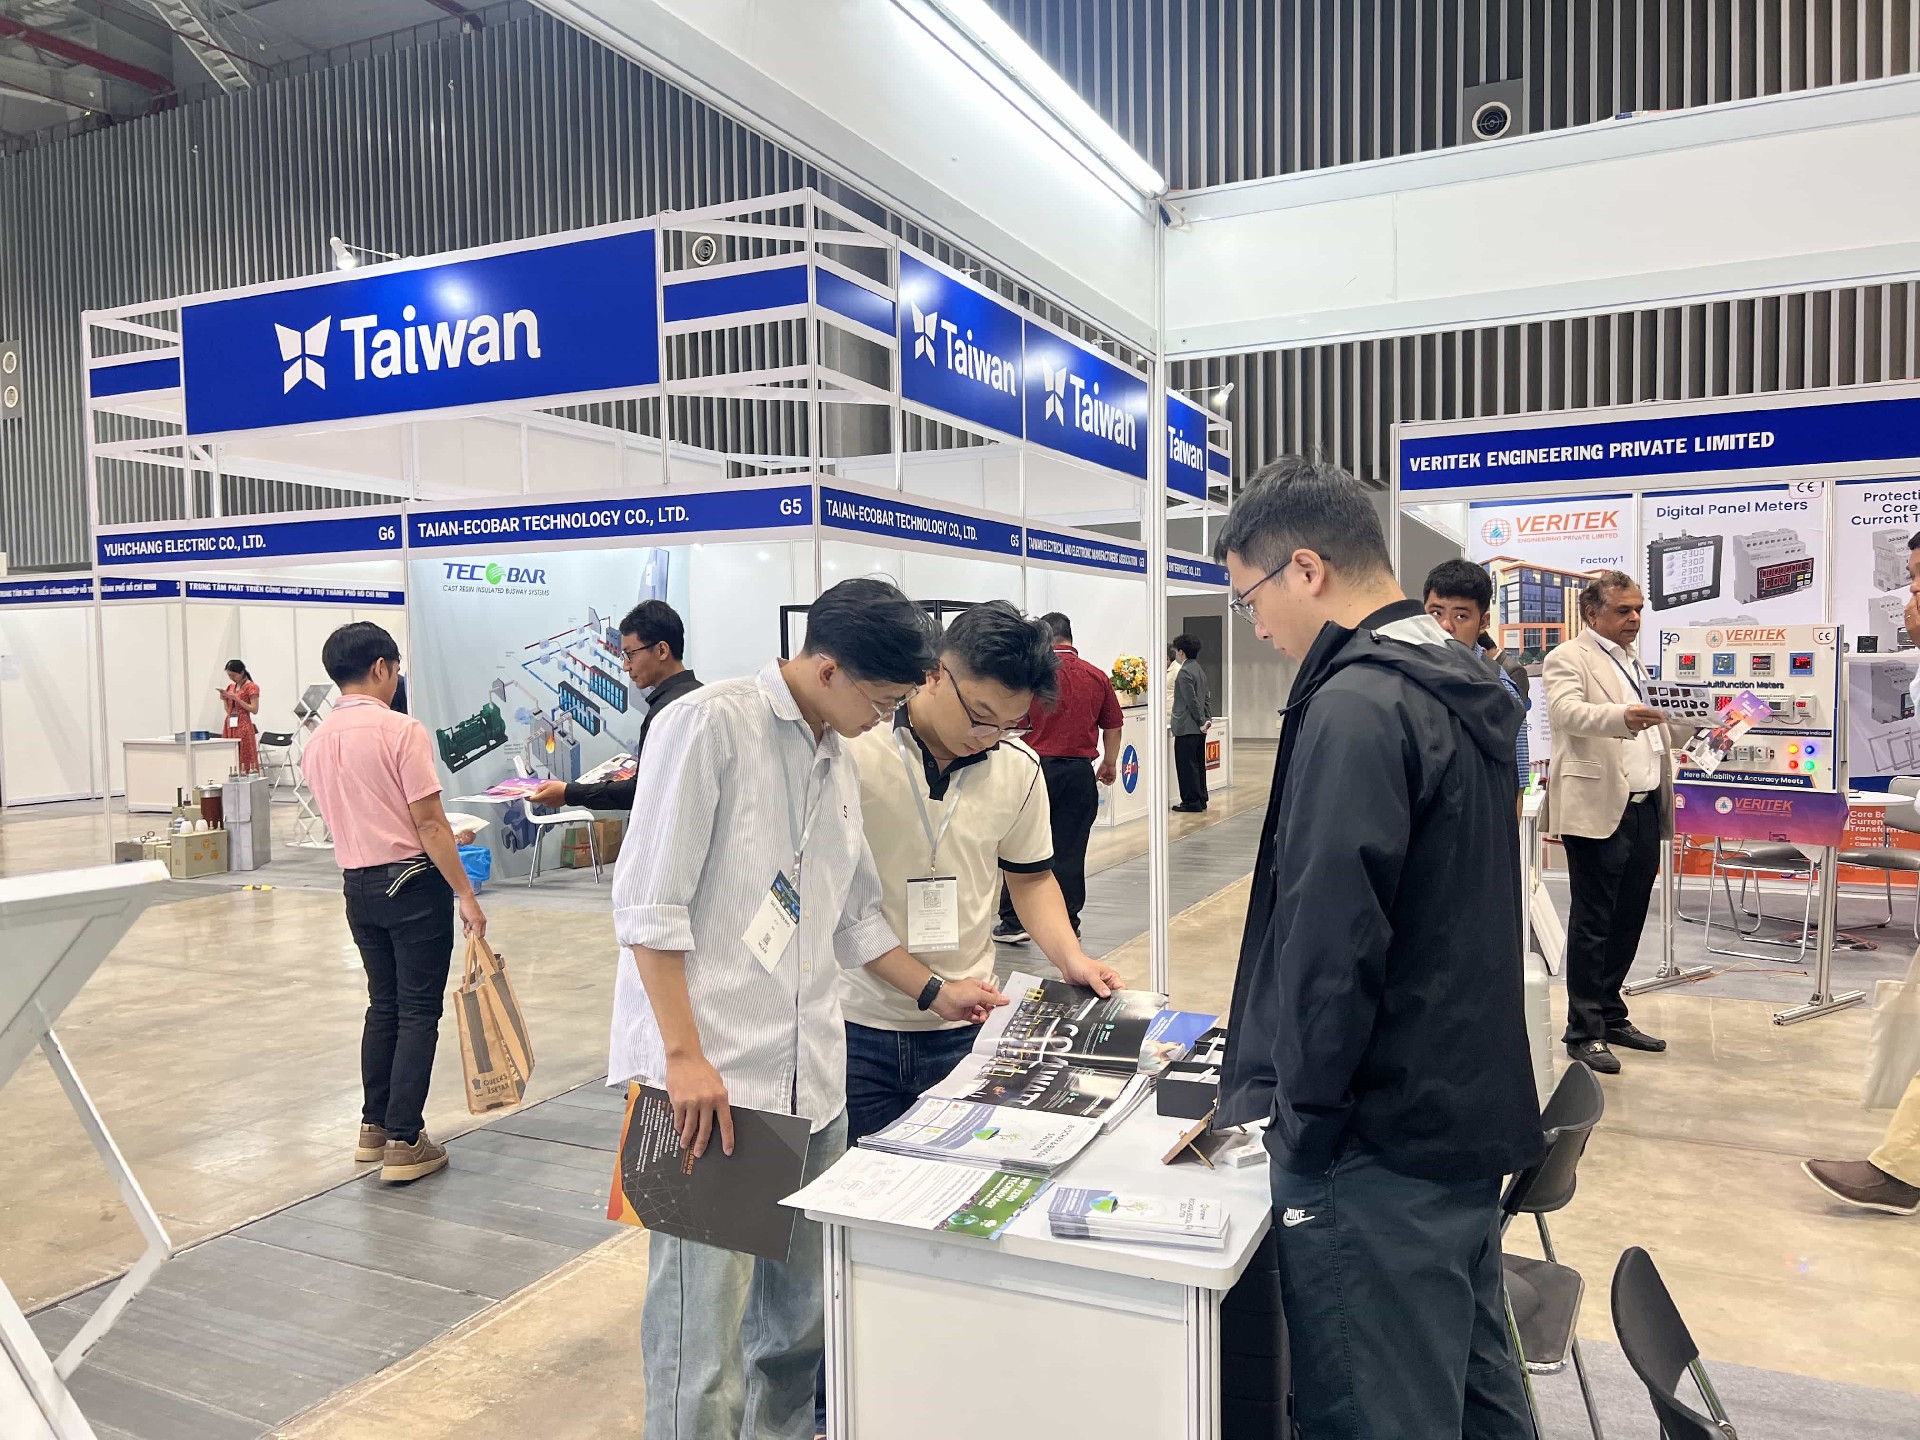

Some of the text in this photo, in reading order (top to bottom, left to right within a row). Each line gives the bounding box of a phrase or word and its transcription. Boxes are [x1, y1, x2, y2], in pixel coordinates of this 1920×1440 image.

[340, 305, 541, 380] Taiwan
[941, 319, 1016, 397] Taiwan
[1069, 373, 1137, 450] Taiwan
[1168, 425, 1204, 472] Taiwan
[1409, 431, 1775, 472] VERITEK ENGINEERING PRIVATE LIMITED
[1656, 500, 1808, 520] Digital Panel Meters
[1882, 503, 1918, 513] Core
[417, 498, 802, 538] TAIAN-ECOBAR TECHNOLOGY CO., LTD. G5
[826, 499, 895, 525] TAIAN-ECOBAR
[895, 512, 948, 535] TECHNOLOGY
[963, 525, 978, 541] LTD.
[1010, 533, 1019, 548] G5
[1515, 510, 1620, 533] VERITEK
[1851, 514, 1909, 525] Current
[103, 526, 395, 557] YUHCHANG ELECTRIC CO., LTD. G6
[1517, 535, 1562, 544] ENGINEERING
[1591, 532, 1619, 540] LIMITED
[1580, 556, 1619, 565] Factory
[443, 584, 458, 592] CAST
[476, 586, 505, 594] INSULATED
[505, 588, 528, 596] BUSWAY
[1725, 628, 1787, 641] VERITEK
[1756, 681, 1785, 690] Meters
[1683, 771, 1700, 779] Here
[1744, 774, 1780, 785] Accuracy
[1734, 798, 1794, 812] VERITEK
[1849, 810, 1873, 818] Core
[1285, 1207, 1306, 1220] NIKE
